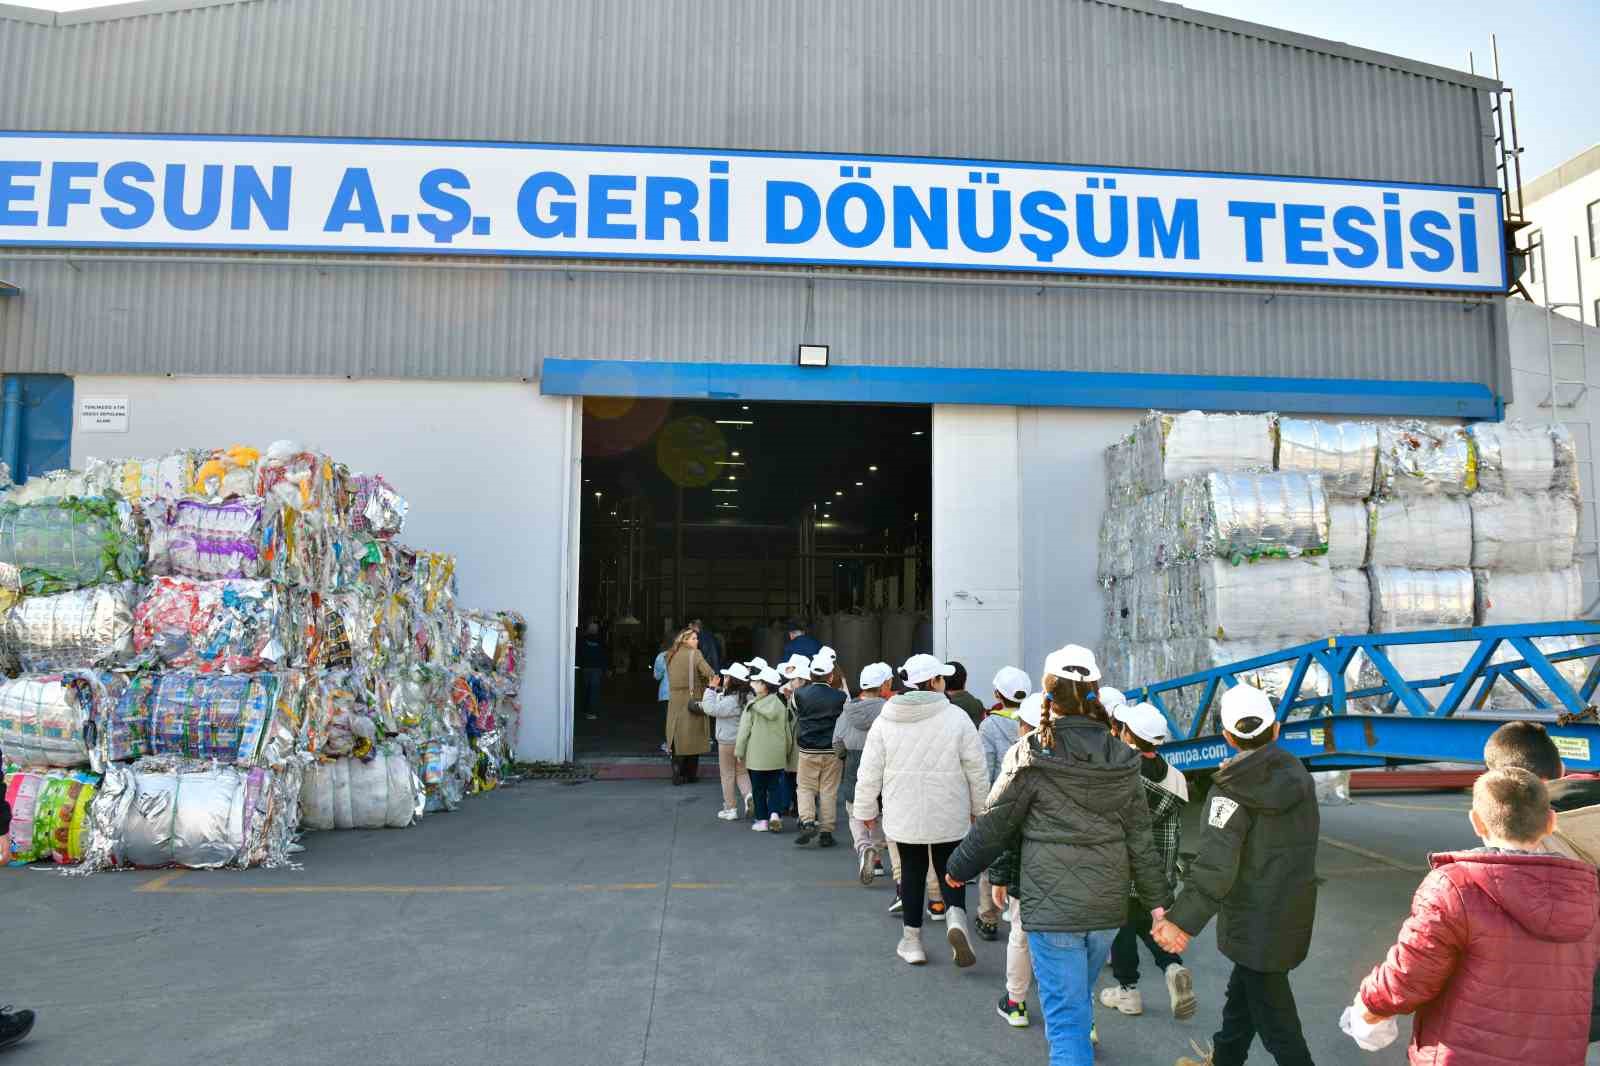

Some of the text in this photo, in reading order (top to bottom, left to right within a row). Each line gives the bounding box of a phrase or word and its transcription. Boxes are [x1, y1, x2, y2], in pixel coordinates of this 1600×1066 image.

[0, 160, 1479, 273] EFSUN A.Ş. GERİ DÖNÜŞÜM TESİSİ
[1160, 744, 1228, 766] rampa.com
